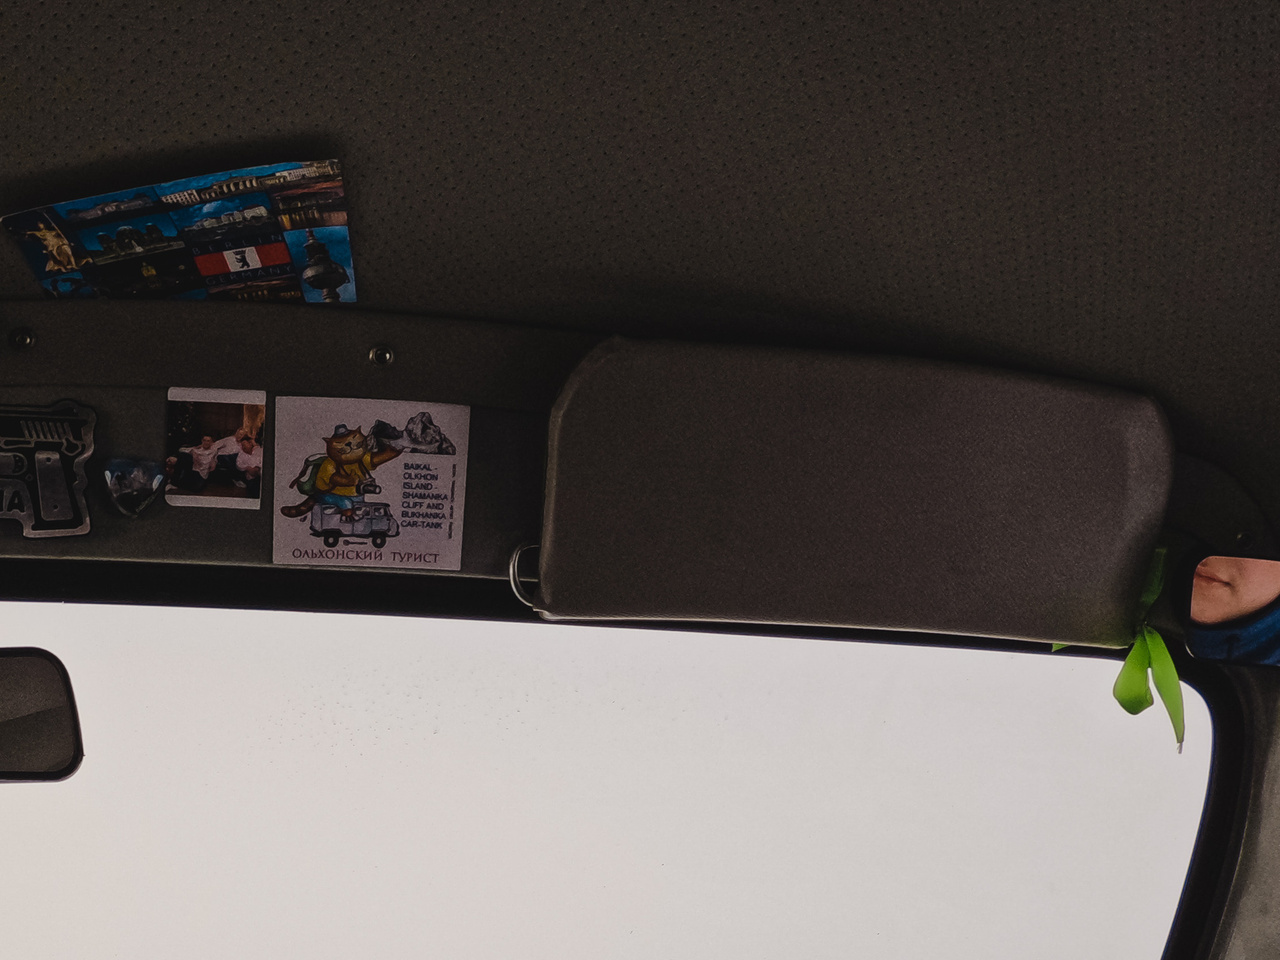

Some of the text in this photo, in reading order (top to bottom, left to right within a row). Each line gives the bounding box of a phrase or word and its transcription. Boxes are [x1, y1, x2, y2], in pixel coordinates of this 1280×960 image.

[192, 234, 282, 255] BERLIN
[205, 265, 291, 285] GERMANY
[403, 463, 432, 471] BAIKAL
[402, 472, 438, 481] OLKHON
[402, 482, 433, 490] ISLAND
[402, 491, 448, 501] SHAMANKA
[401, 501, 444, 511] CLIFF AND
[401, 511, 446, 520] BUKHANKA
[400, 520, 443, 530] CAR-TANK
[292, 548, 440, 564] ОЛЬХОНСКИЙ ТУРИСТ
